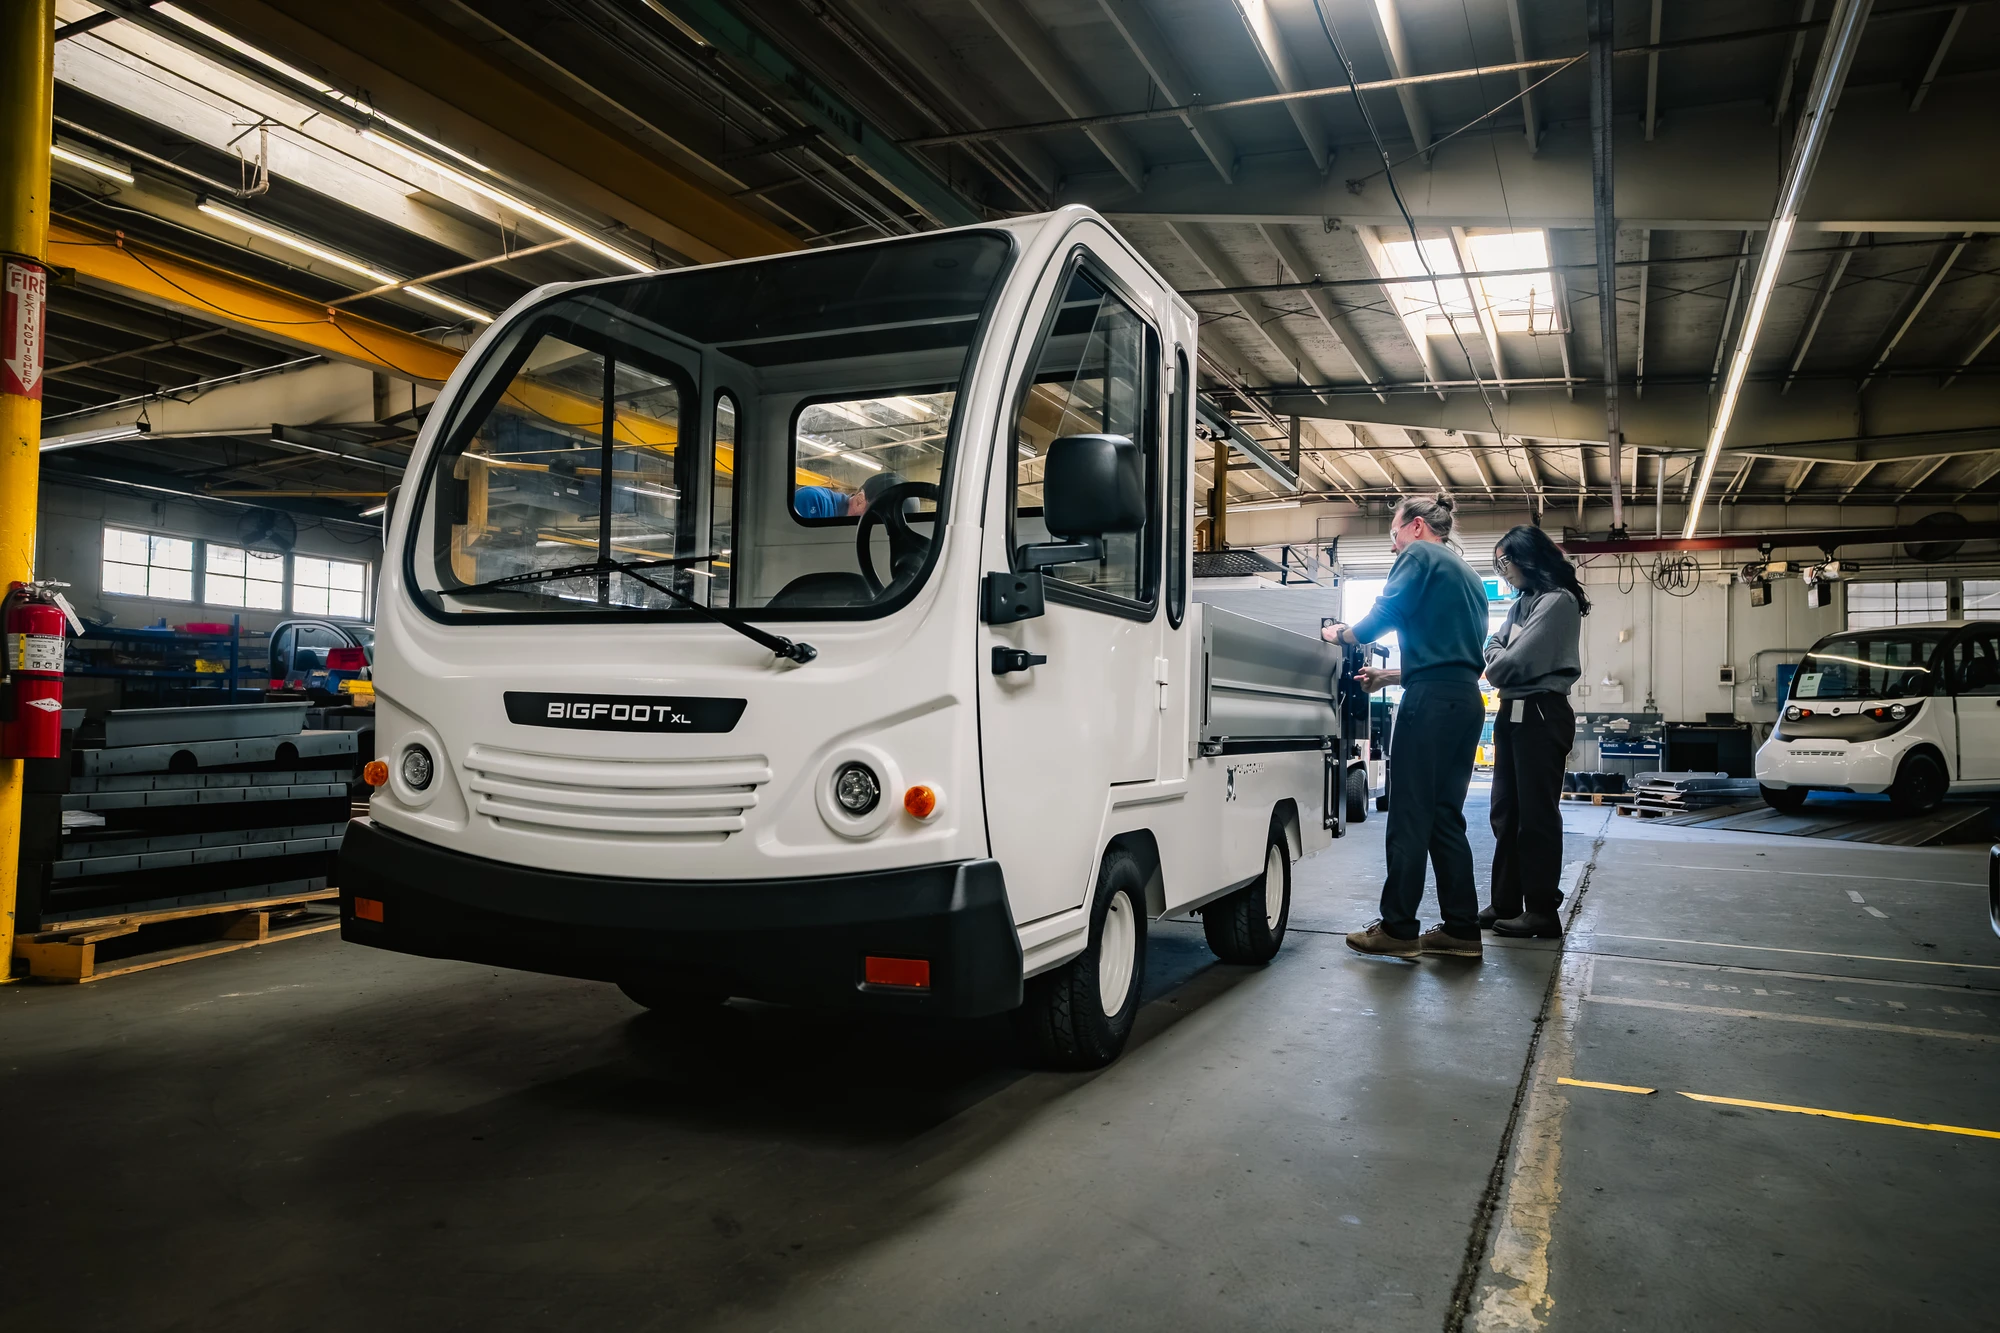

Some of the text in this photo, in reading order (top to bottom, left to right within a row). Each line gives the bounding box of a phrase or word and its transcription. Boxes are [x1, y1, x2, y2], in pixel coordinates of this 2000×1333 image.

[11, 271, 45, 297] FIRE
[22, 293, 35, 385] EXTINGUISHER
[547, 702, 692, 724] BIGFOOT XL
